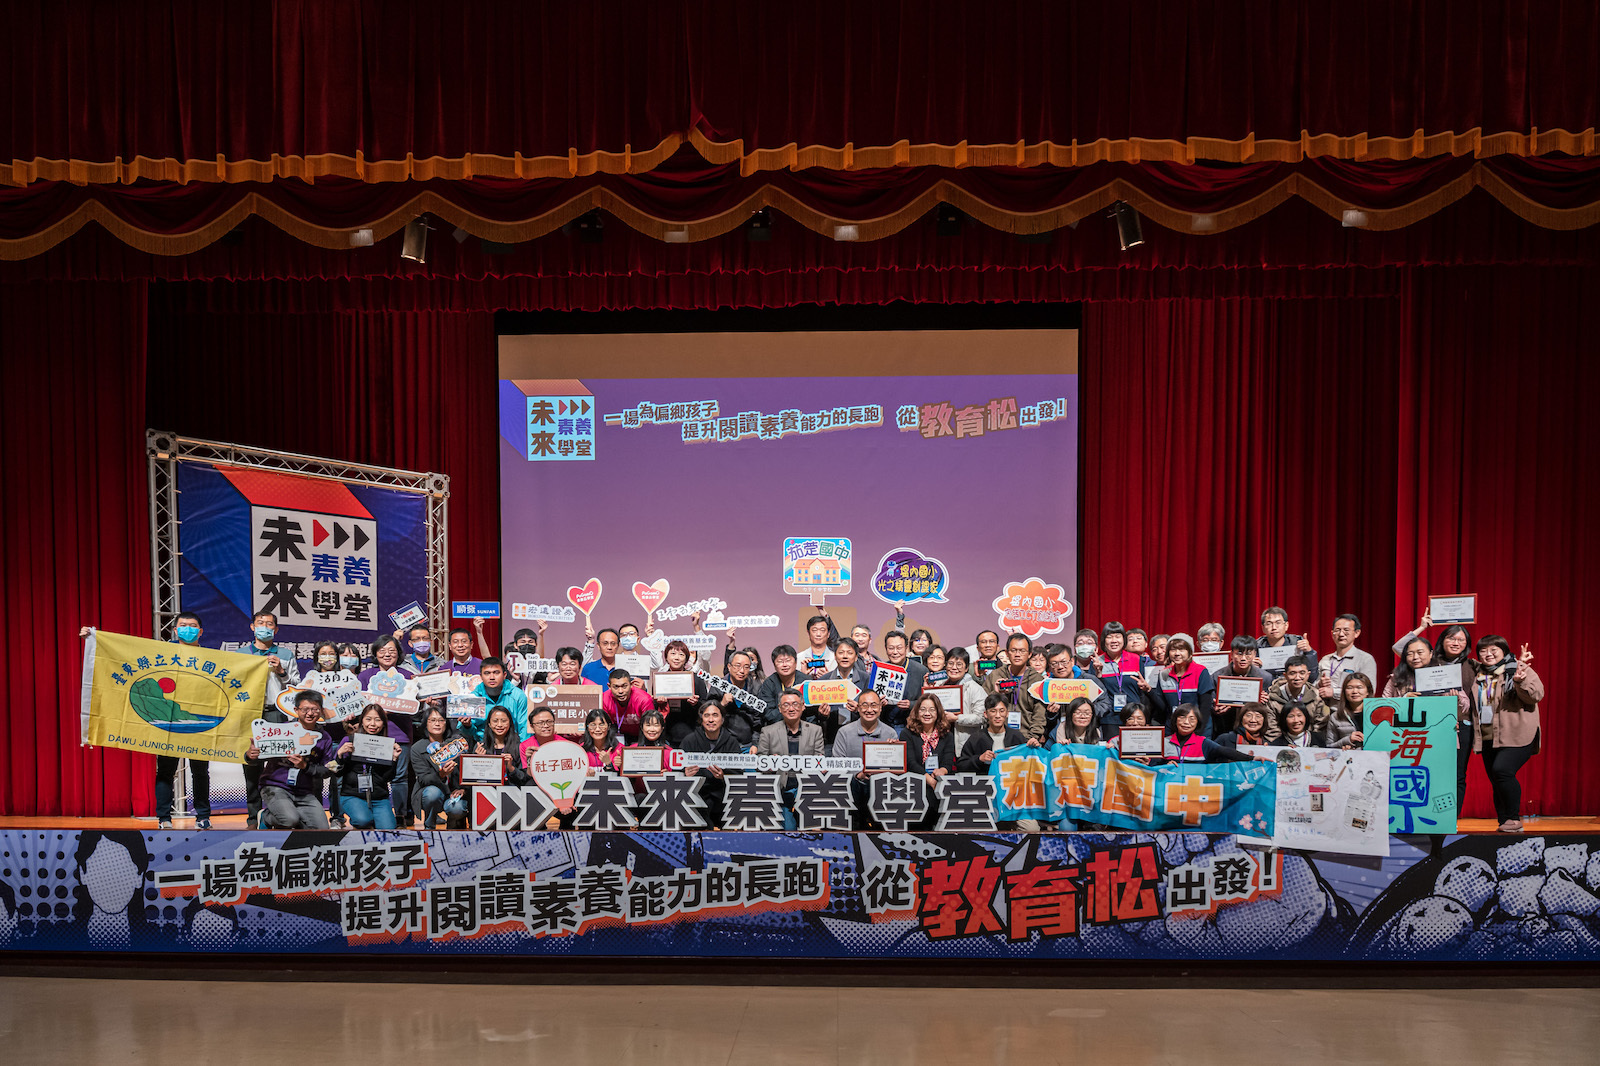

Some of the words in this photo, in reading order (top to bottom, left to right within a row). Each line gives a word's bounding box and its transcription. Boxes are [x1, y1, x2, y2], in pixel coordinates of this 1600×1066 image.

[605, 401, 718, 425] 一場為偏鄉孩子
[683, 405, 880, 439] 提升閱讀素養能力的長跑
[530, 399, 556, 457] 未來
[557, 418, 592, 436] 素養
[557, 439, 592, 457] 學堂
[259, 516, 307, 618] 未來
[311, 553, 372, 587] 素養
[311, 590, 372, 622] 學堂
[456, 604, 476, 614] 順發
[528, 606, 573, 616] 宏遠證券
[710, 676, 766, 712] 未來素養學堂
[811, 684, 846, 693] PaGamO
[875, 670, 889, 695] 未來
[887, 689, 901, 700] 學堂
[888, 680, 903, 691] 素養
[1051, 683, 1087, 691] PaGamO
[108, 734, 137, 745] DAWU
[138, 739, 174, 751] JUNIOR
[176, 745, 199, 755] HIGH
[201, 748, 239, 759] SCHOOL
[688, 754, 756, 762] 社團法人台灣素養教育協會
[534, 757, 586, 773] 社子國小
[760, 757, 824, 769] SYSTEX
[826, 759, 862, 769] 精誠資訊
[575, 774, 995, 830] 未來素養學堂
[158, 844, 425, 899] 一場為偏鄉孩子
[345, 861, 820, 934] 提升閱讀素養能力的長跑
[865, 846, 1277, 940] 從教育松出發!
